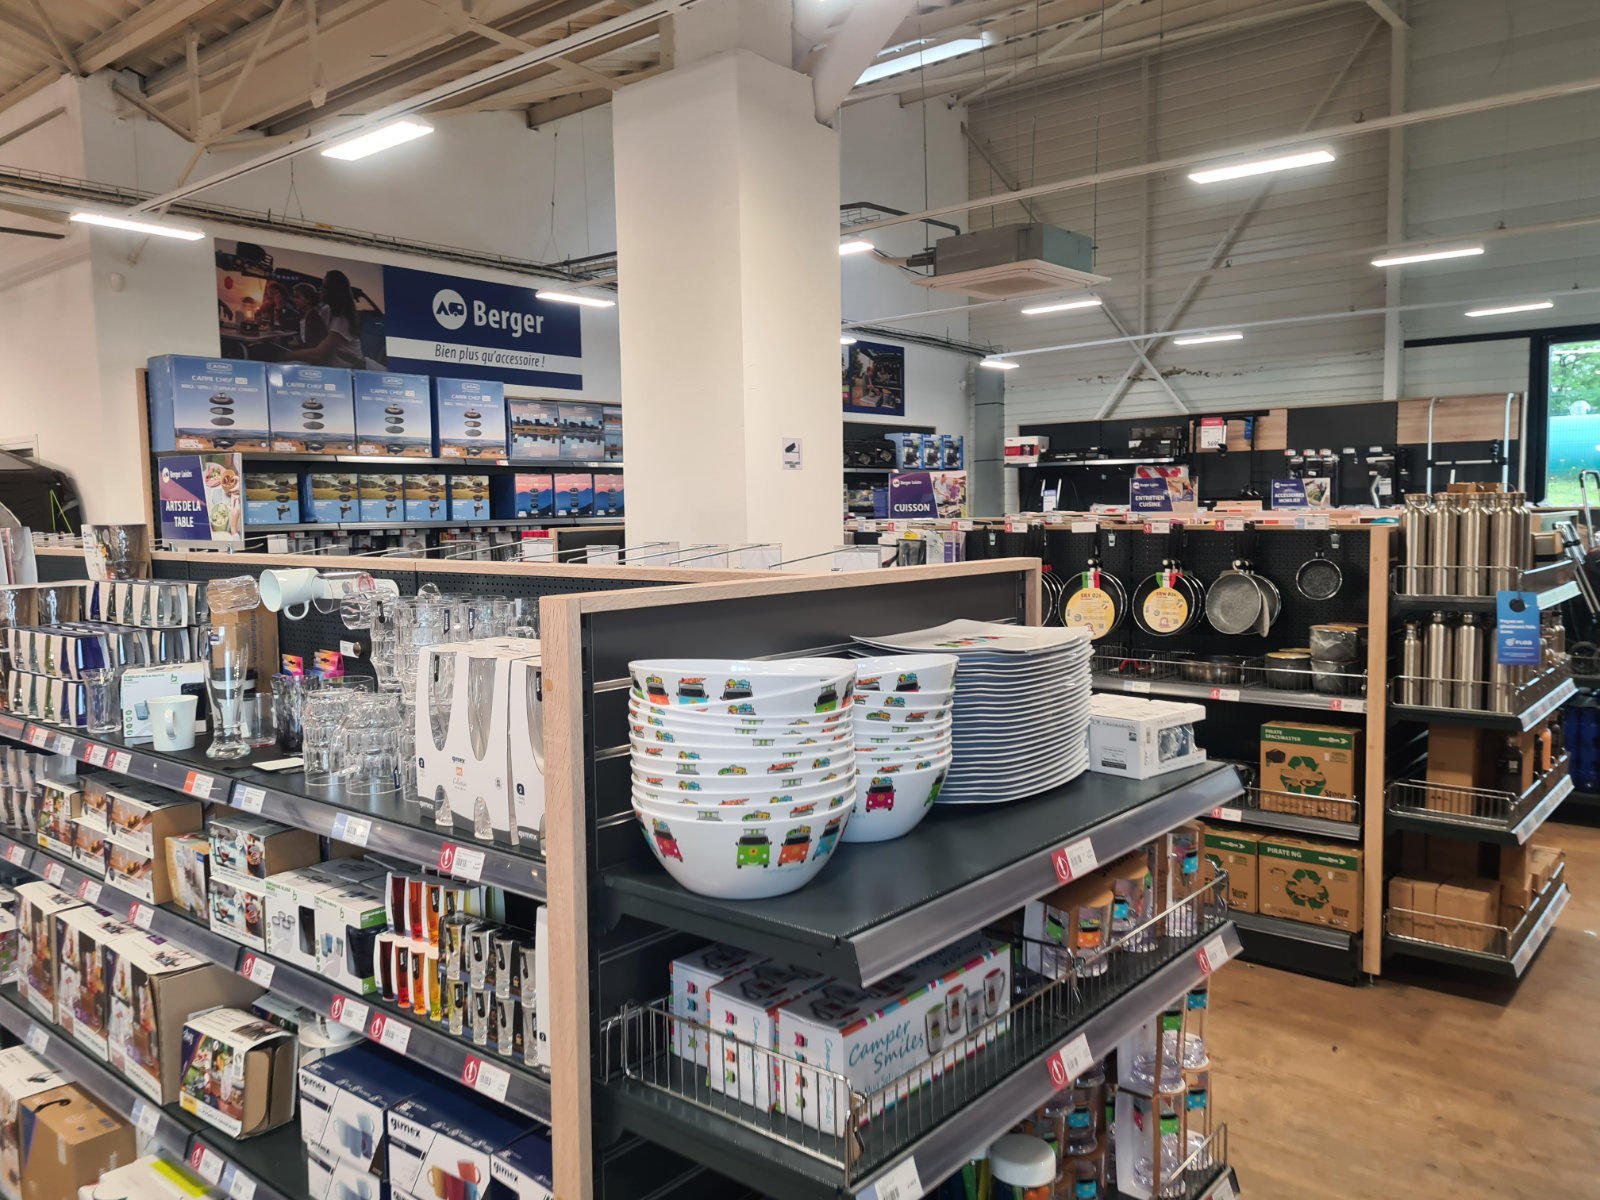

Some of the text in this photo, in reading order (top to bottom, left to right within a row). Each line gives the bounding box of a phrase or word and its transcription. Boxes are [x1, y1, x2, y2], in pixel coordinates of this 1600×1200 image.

[473, 299, 544, 338] Berger
[434, 343, 456, 358] Bien
[459, 347, 479, 362] plus
[481, 350, 539, 367] qu'accessoire
[165, 500, 202, 511] ARTS DE LA
[893, 503, 931, 512] CUISSON
[174, 516, 195, 528] TABLE
[1264, 733, 1301, 741] SPACEMASTER
[1266, 846, 1302, 858] PIRATE NG
[848, 1019, 911, 1068] Camper
[874, 1033, 924, 1075] Smiles
[301, 1074, 326, 1093] gimex
[390, 1117, 421, 1137] gimex
[493, 1161, 518, 1182] gimex
